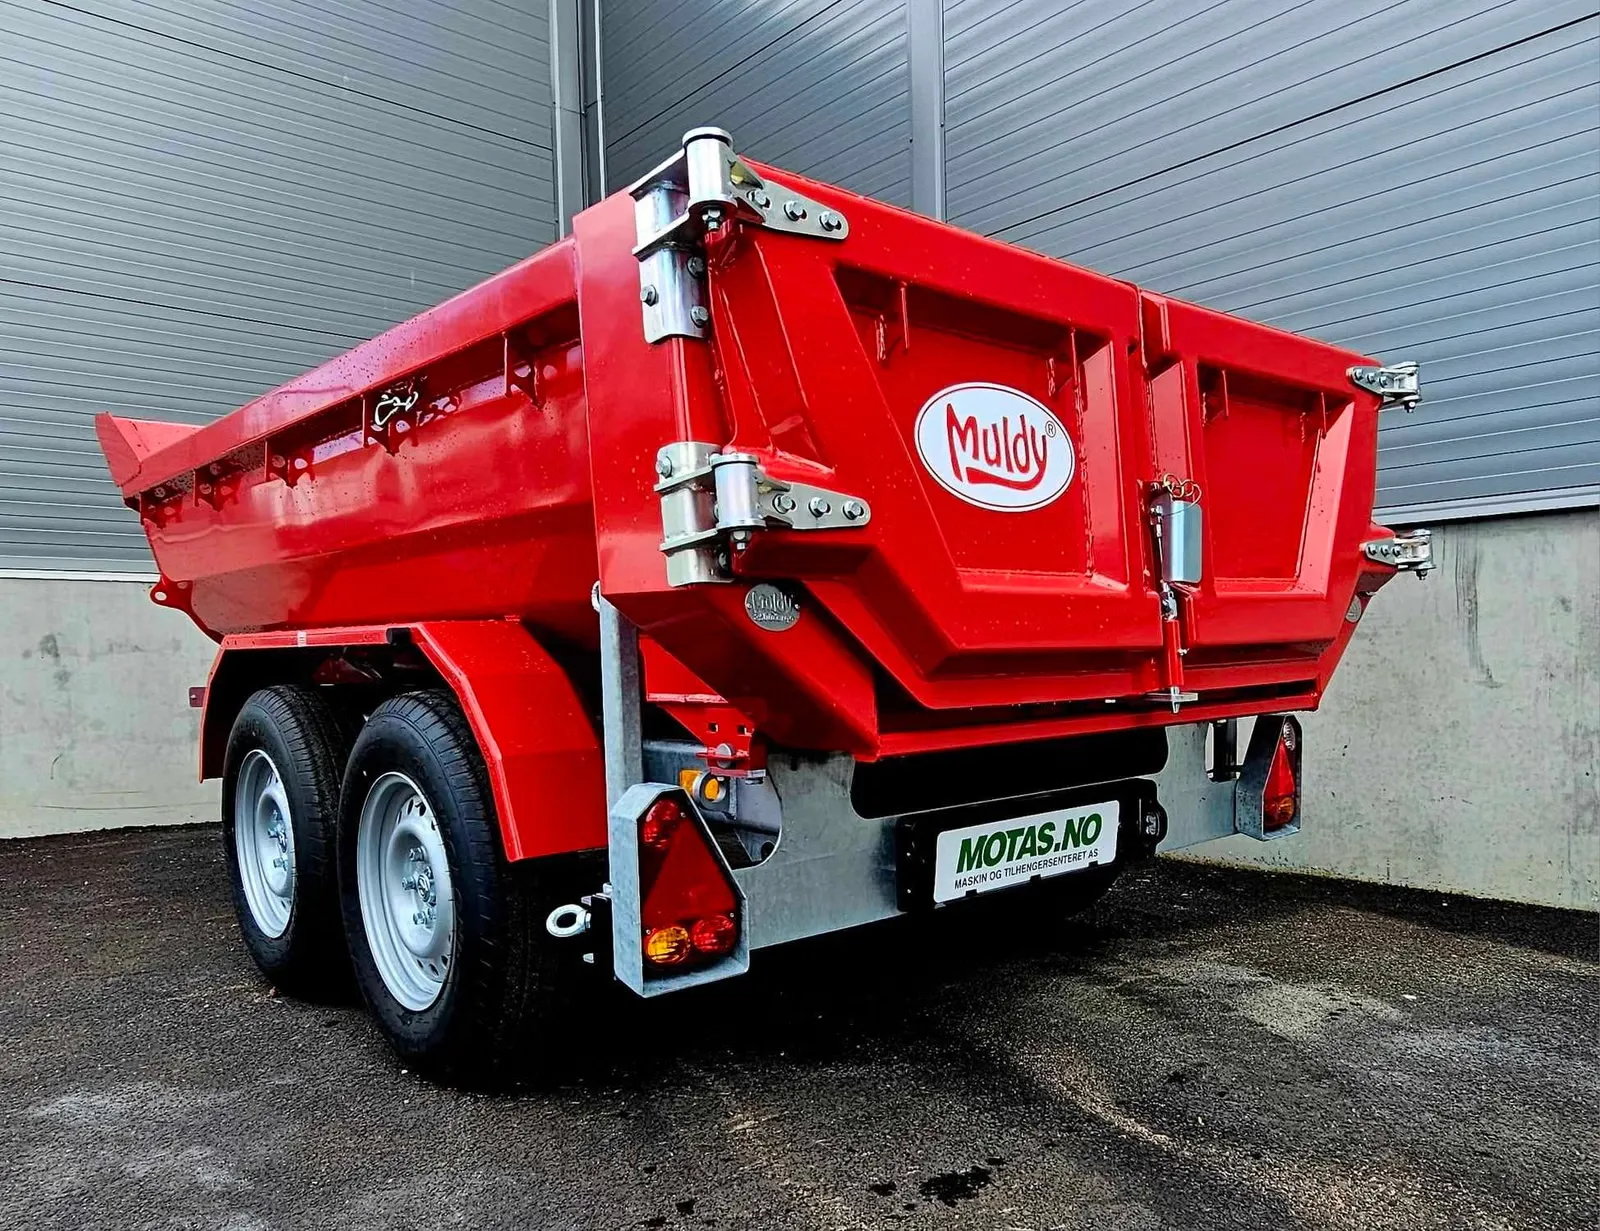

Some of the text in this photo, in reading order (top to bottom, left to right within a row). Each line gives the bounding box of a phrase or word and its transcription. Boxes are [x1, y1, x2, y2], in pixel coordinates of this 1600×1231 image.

[956, 813, 1102, 873] MOTAS.NO
[955, 848, 1098, 890] MASKIN OG TILHENGERSENTERET AS
